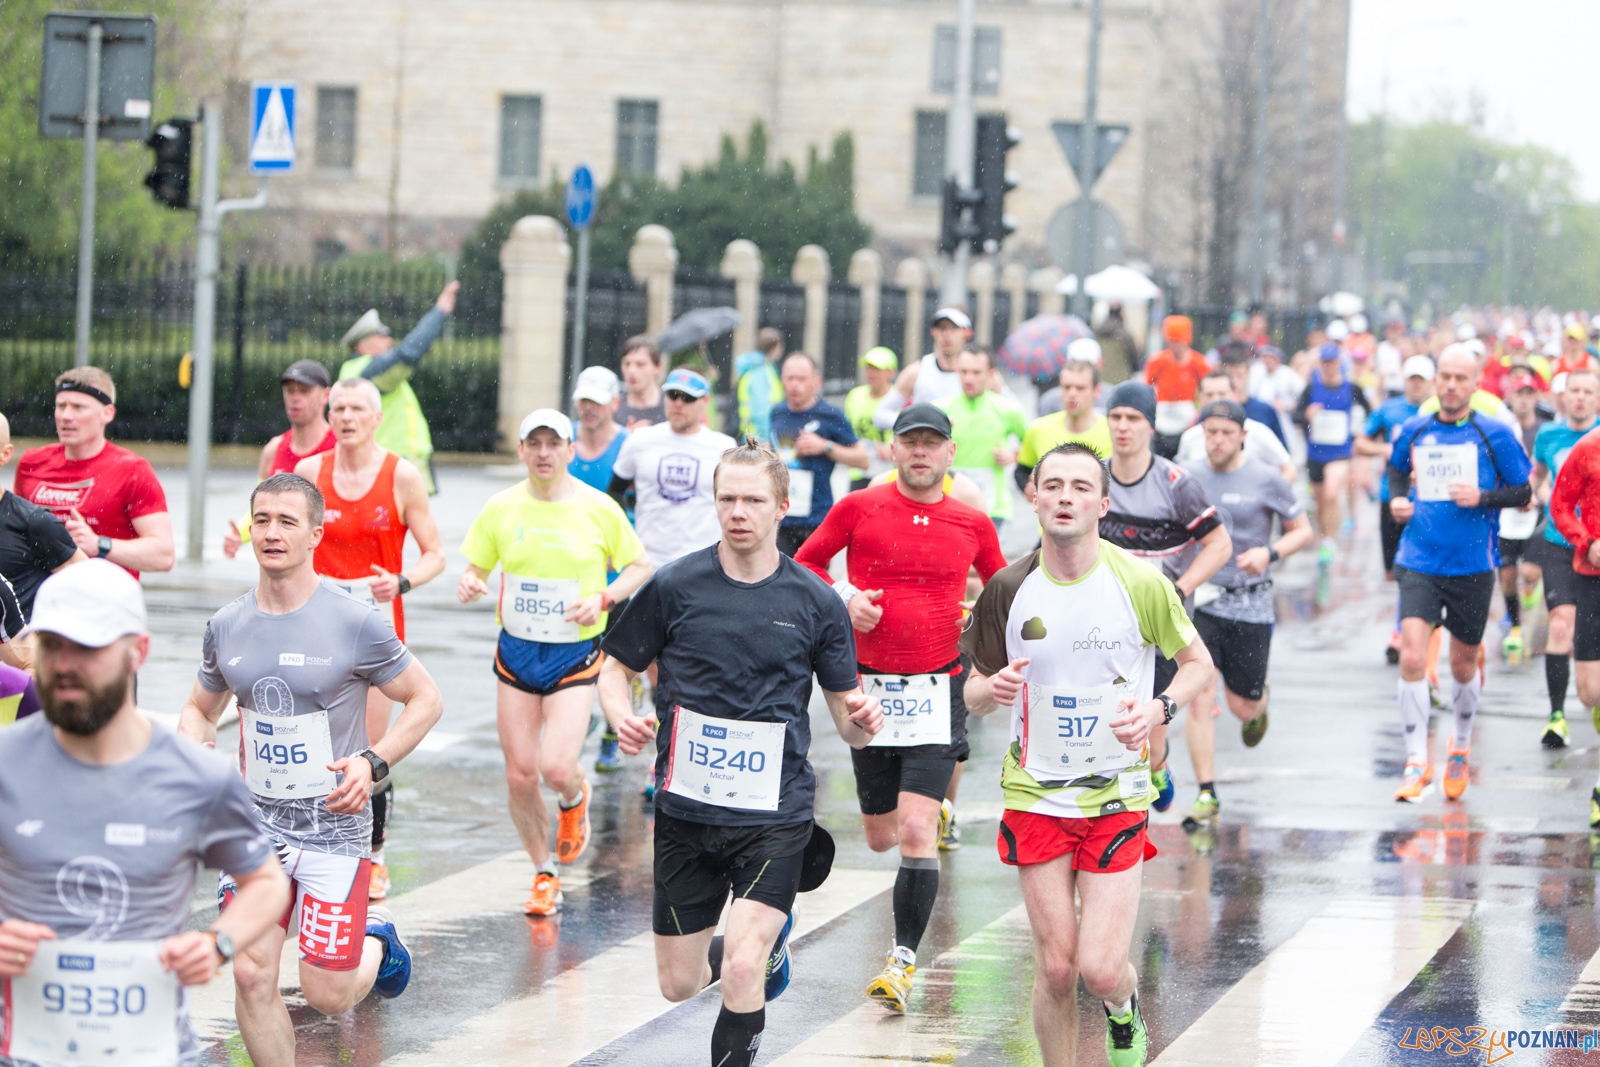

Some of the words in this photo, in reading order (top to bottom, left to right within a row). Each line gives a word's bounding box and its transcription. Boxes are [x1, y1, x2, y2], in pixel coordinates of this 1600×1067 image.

[1426, 463, 1462, 477] 4951
[35, 485, 81, 502] Lorenz
[514, 597, 565, 616] 8854
[1072, 629, 1121, 652] parkrun
[705, 727, 724, 737] 9.PKO
[1058, 715, 1099, 737] 317
[253, 739, 308, 765] 1496
[688, 740, 766, 773] 13240
[269, 767, 288, 775] Jakub
[709, 771, 735, 781] Michał
[43, 982, 146, 1016] 9330
